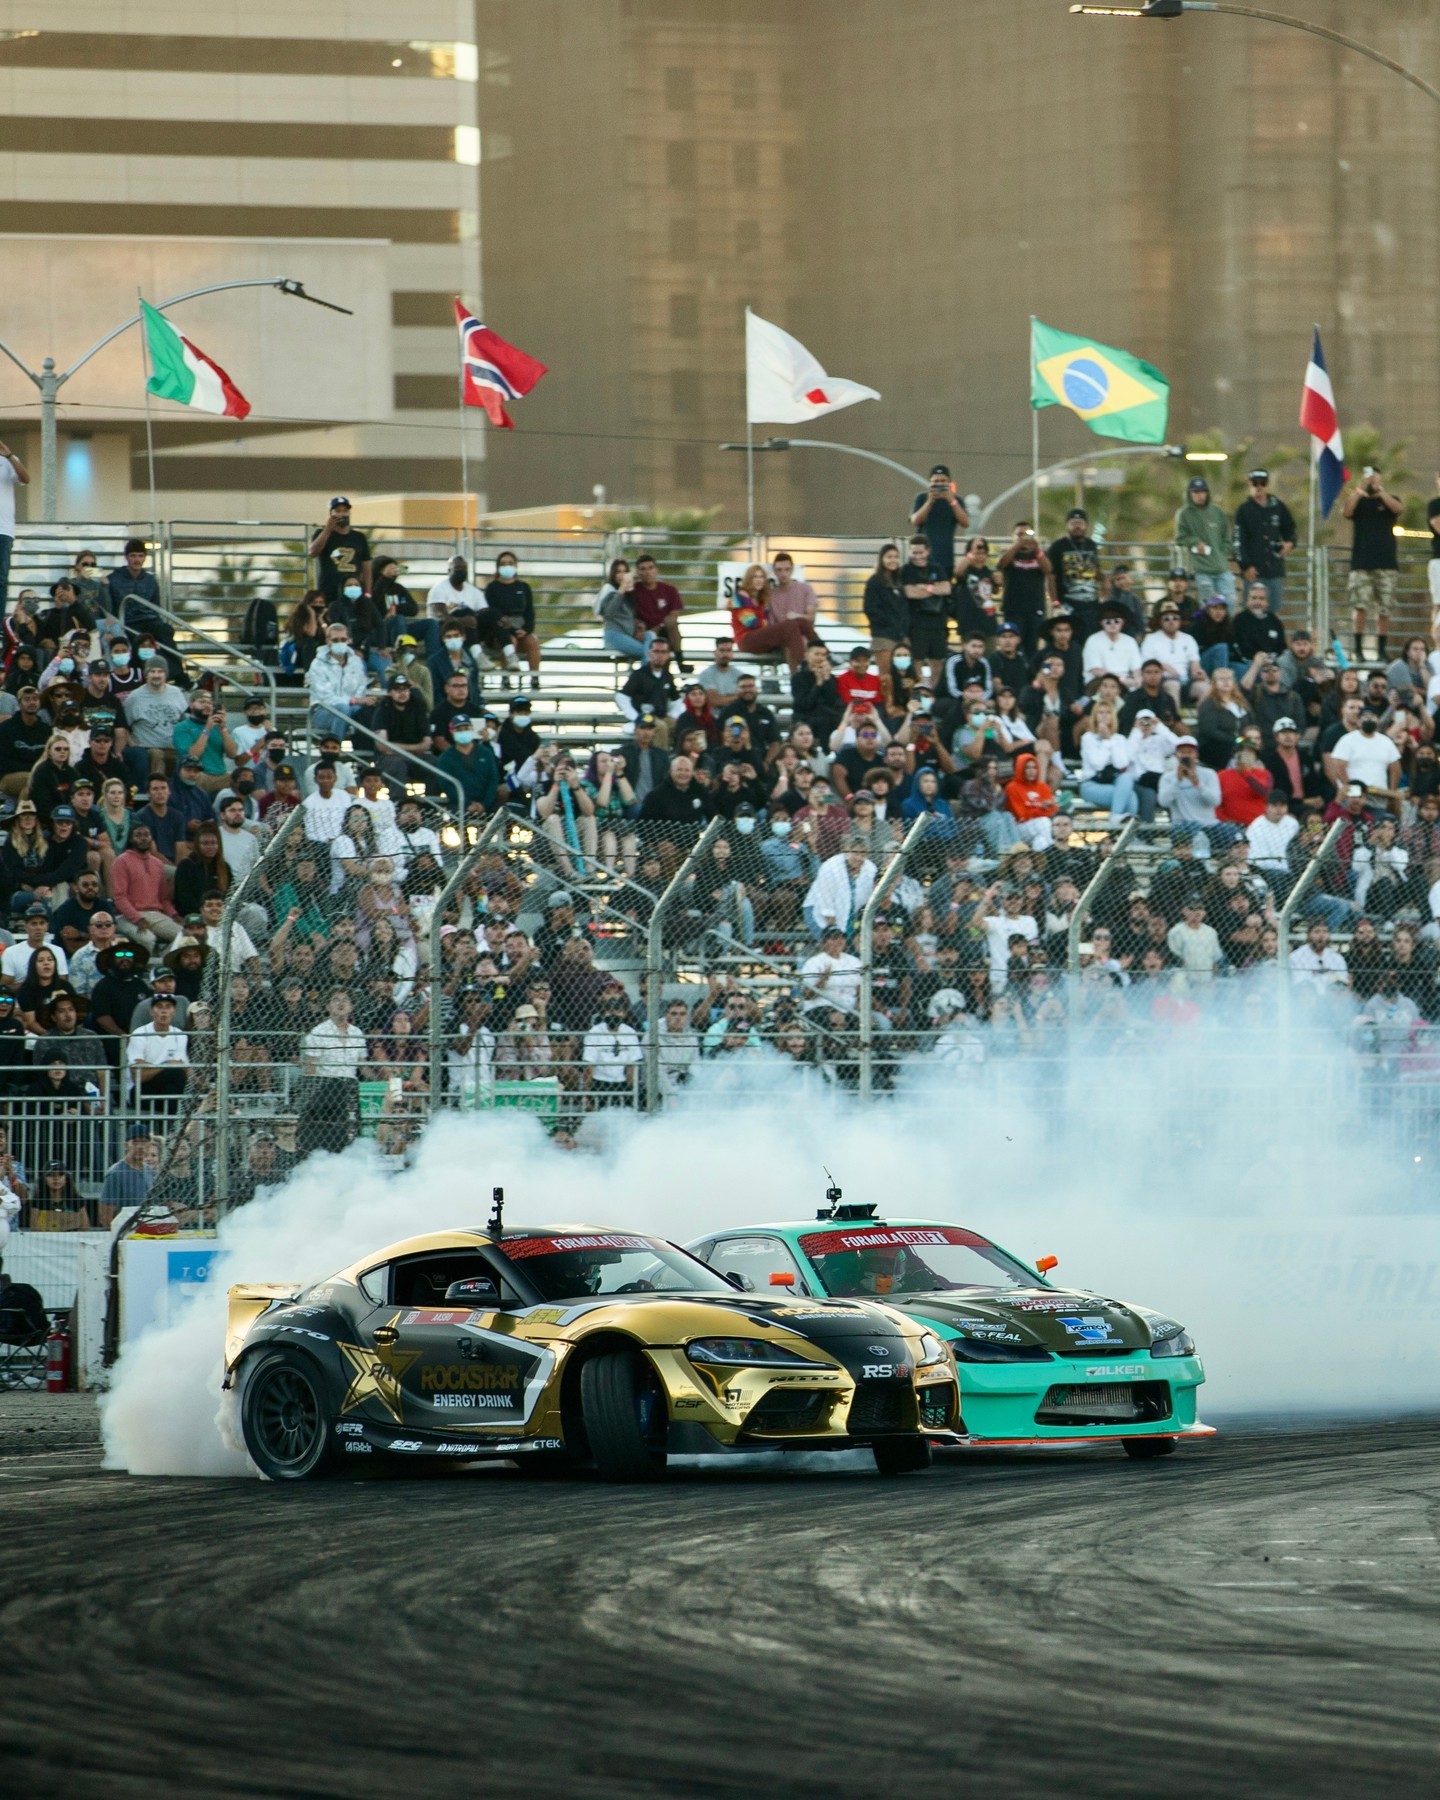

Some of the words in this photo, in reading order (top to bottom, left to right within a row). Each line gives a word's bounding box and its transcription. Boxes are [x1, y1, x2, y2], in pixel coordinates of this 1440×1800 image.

[551, 1235, 610, 1250] FORMULA
[841, 1232, 900, 1248] FORMULA
[897, 1231, 950, 1244] DRIFT
[987, 1331, 1022, 1341] FEAL
[1085, 1364, 1145, 1376] FALKEN
[420, 1364, 520, 1391] ROCKSTAR
[768, 1374, 840, 1384] NITTO
[433, 1393, 477, 1407] ENERGY
[478, 1394, 514, 1408] DRINK
[674, 1400, 707, 1409] CSF
[342, 1423, 364, 1433] EFR
[532, 1439, 561, 1449] CTEK
